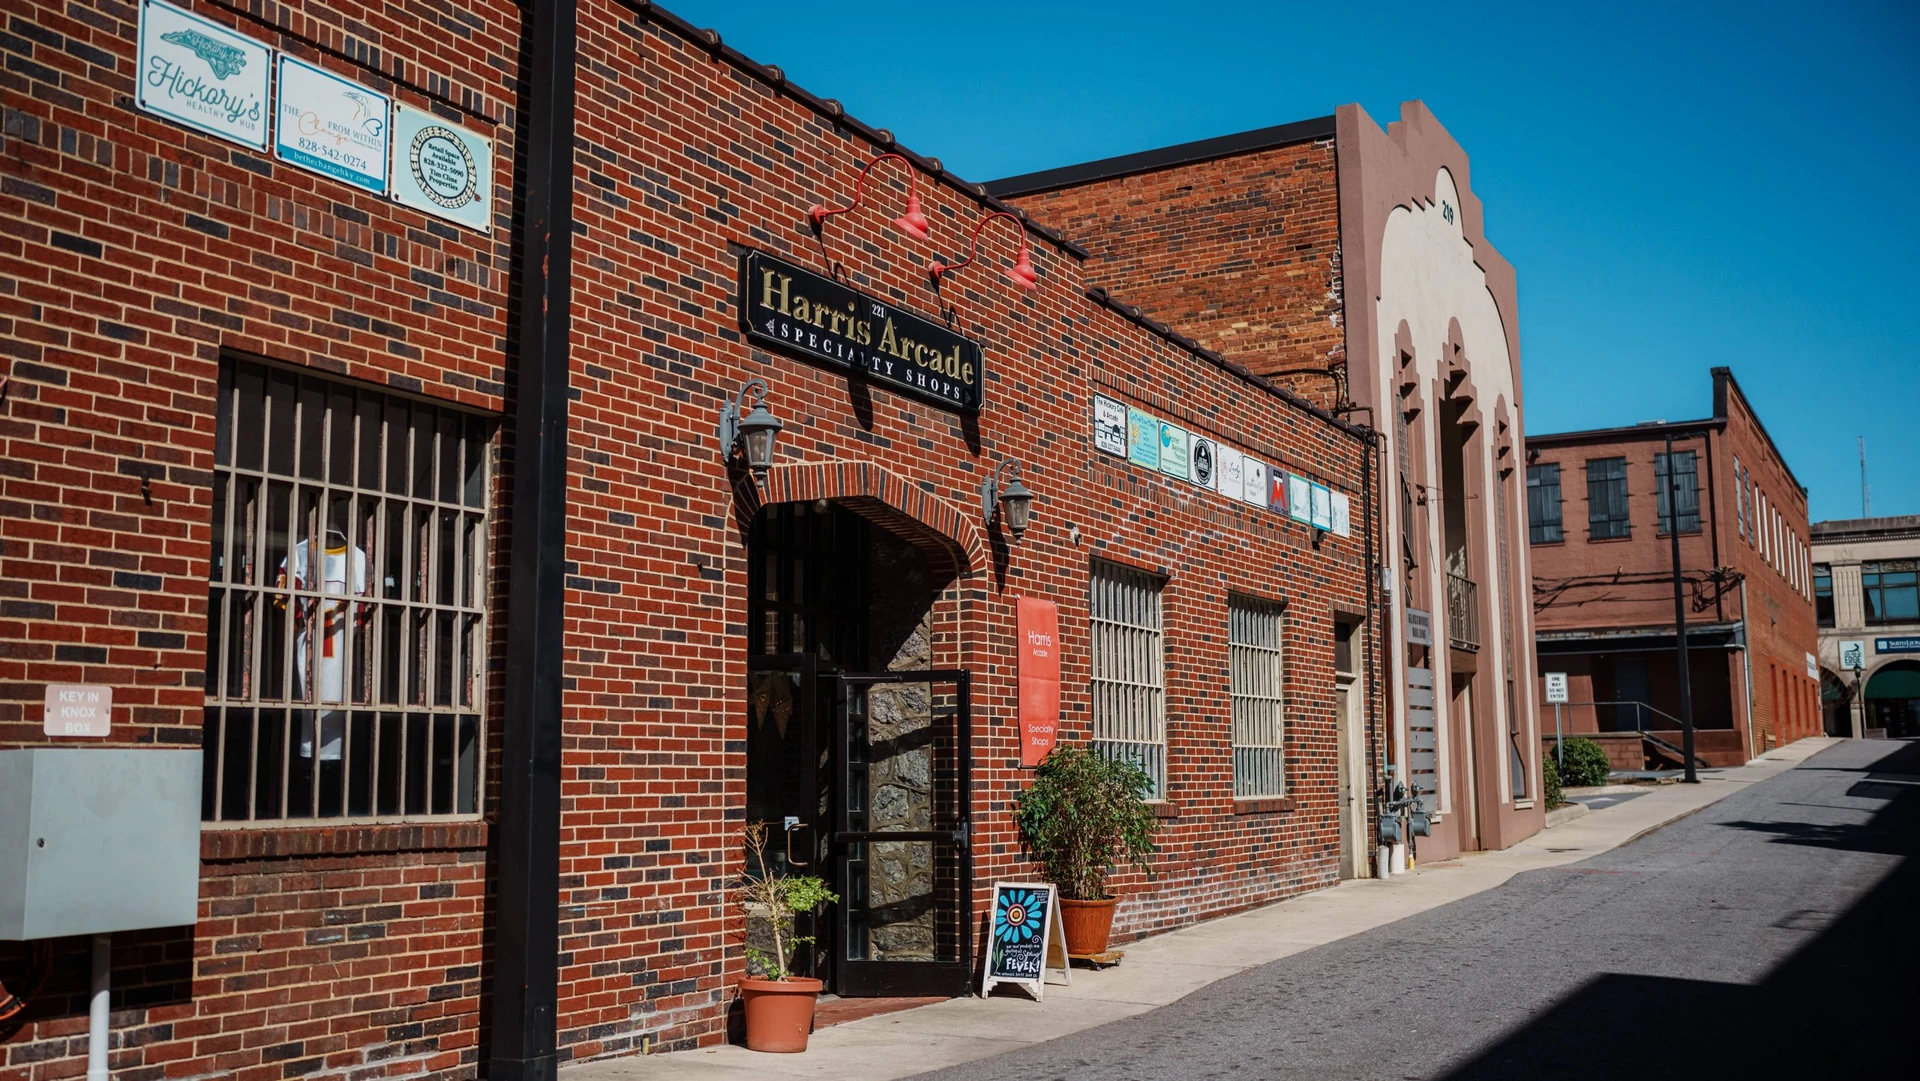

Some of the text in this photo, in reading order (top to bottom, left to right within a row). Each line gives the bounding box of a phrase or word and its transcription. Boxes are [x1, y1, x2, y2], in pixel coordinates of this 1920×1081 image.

[147, 55, 260, 123] Hickory's
[186, 100, 256, 131] HEALTHY HUB
[282, 103, 300, 117] THE
[298, 111, 348, 145] Change
[328, 121, 351, 136] FROM
[353, 129, 382, 148] WITHIN
[298, 137, 366, 170] 828-542-0274
[428, 143, 460, 160] Retail Space
[432, 152, 456, 166] Available
[294, 151, 370, 185] bethechangehky.com
[423, 157, 464, 178] 828-322-5090
[429, 175, 458, 191] Properties
[430, 168, 458, 184] Tim Cline
[1442, 199, 1454, 226] 219
[871, 303, 885, 319] 221
[760, 265, 974, 385] Harris Arcade
[781, 323, 960, 400] SPECIALTY SHOPS
[1028, 630, 1052, 647] Harris
[1032, 648, 1047, 658] Arcade
[59, 691, 99, 702] KEY IN
[61, 707, 96, 718] KNOX
[64, 722, 91, 733] BOX
[1028, 723, 1054, 735] Specialty
[1031, 736, 1049, 747] Shops
[1006, 957, 1040, 973] FEVER!
